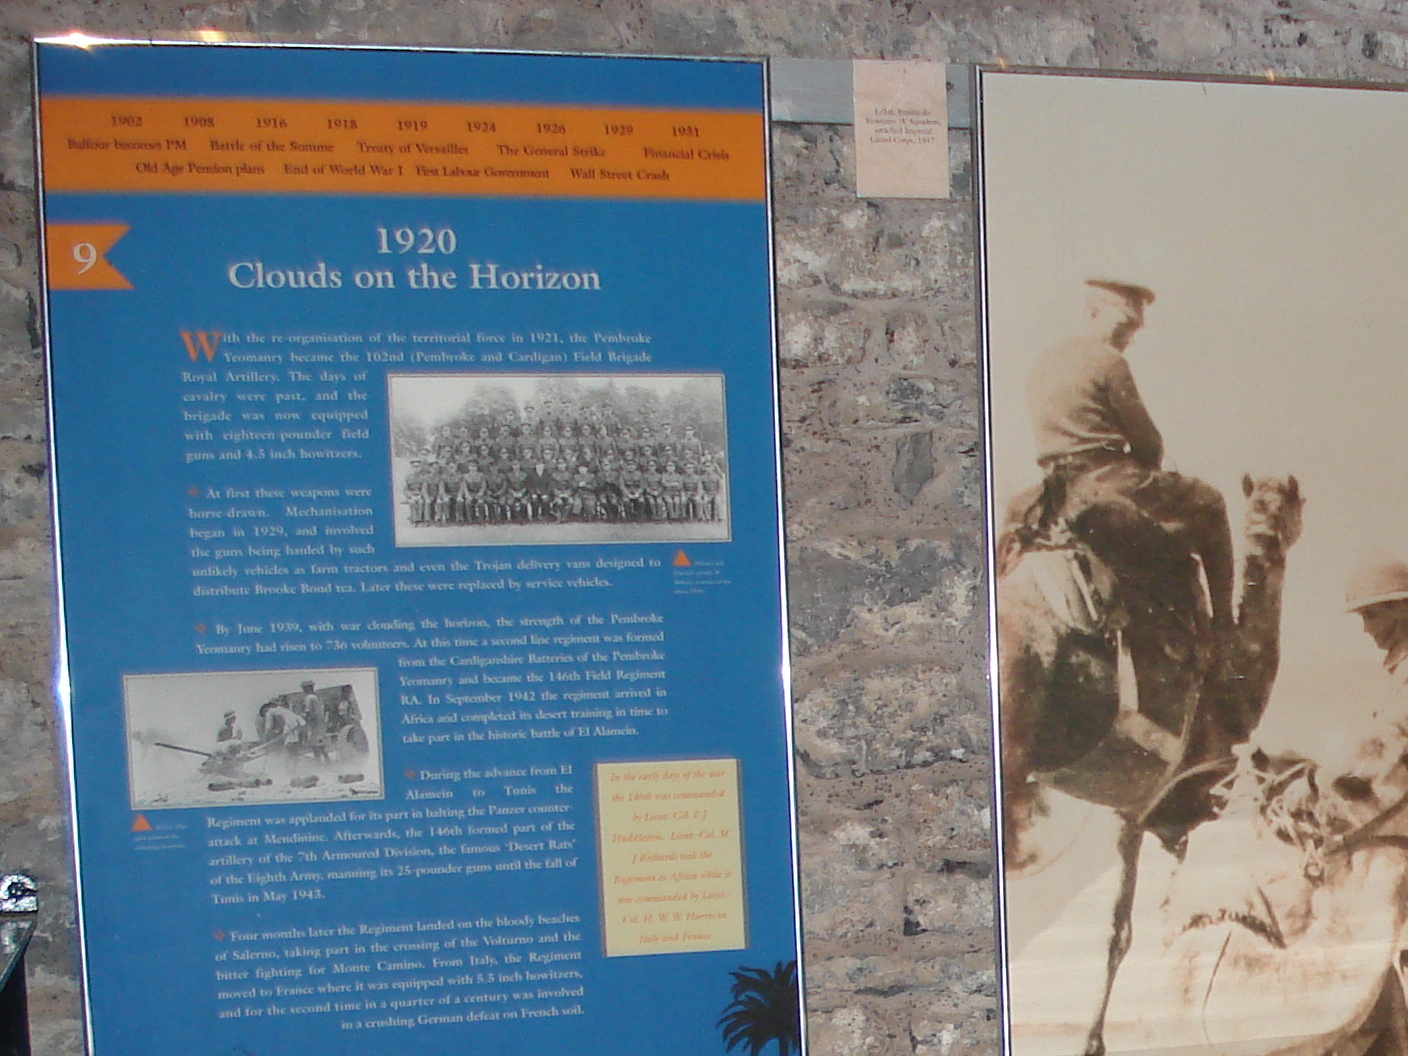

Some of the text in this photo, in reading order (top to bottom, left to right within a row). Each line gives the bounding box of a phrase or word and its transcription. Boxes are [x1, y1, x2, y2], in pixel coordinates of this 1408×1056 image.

[378, 227, 457, 254] 1920
[72, 243, 97, 274] 9
[228, 261, 600, 290] Clouds on the Horizon
[246, 332, 265, 343] the
[369, 333, 382, 343] of
[388, 332, 407, 343] the
[412, 332, 471, 343] territorial
[477, 332, 505, 343] force
[512, 333, 524, 343] in
[531, 332, 564, 343] 1921,
[570, 332, 587, 343] the
[595, 332, 651, 343] Pembroke
[224, 352, 282, 363] Yeomanry
[291, 352, 334, 363] became
[340, 352, 359, 362] the
[367, 351, 404, 362] 102nd
[482, 352, 503, 363] and
[509, 352, 567, 364] Cardigan)
[574, 351, 602, 362] Field
[608, 351, 652, 365] Brigade
[183, 371, 217, 384] Royal
[288, 370, 312, 382] The
[320, 370, 346, 383] days
[354, 371, 368, 381] of
[186, 448, 362, 464] guns and 4.5 inch howitzers.
[231, 913, 580, 942] Four months later the Regiment landed on the bloody beaches
[216, 931, 581, 962] of Salerno, taking part in the crossing of the Volturno and the
[216, 970, 249, 981] bitter
[256, 967, 303, 980] fighting
[309, 965, 326, 975] for
[334, 963, 370, 974] Monte
[377, 960, 425, 971] Camino.
[433, 957, 463, 968] From
[505, 953, 522, 964] the
[530, 952, 582, 964] Regiment
[218, 987, 256, 1000] moved
[260, 989, 273, 997] to
[276, 986, 314, 996] France
[318, 983, 352, 993] where
[356, 981, 365, 991] it
[367, 982, 389, 990] was
[391, 977, 444, 991] equipped
[448, 974, 473, 985] with
[499, 971, 523, 983] inch
[220, 986, 584, 1019] and for the second time in a quarter of a century was involved
[342, 1005, 585, 1030] in a crushing German defeat on French soil.
